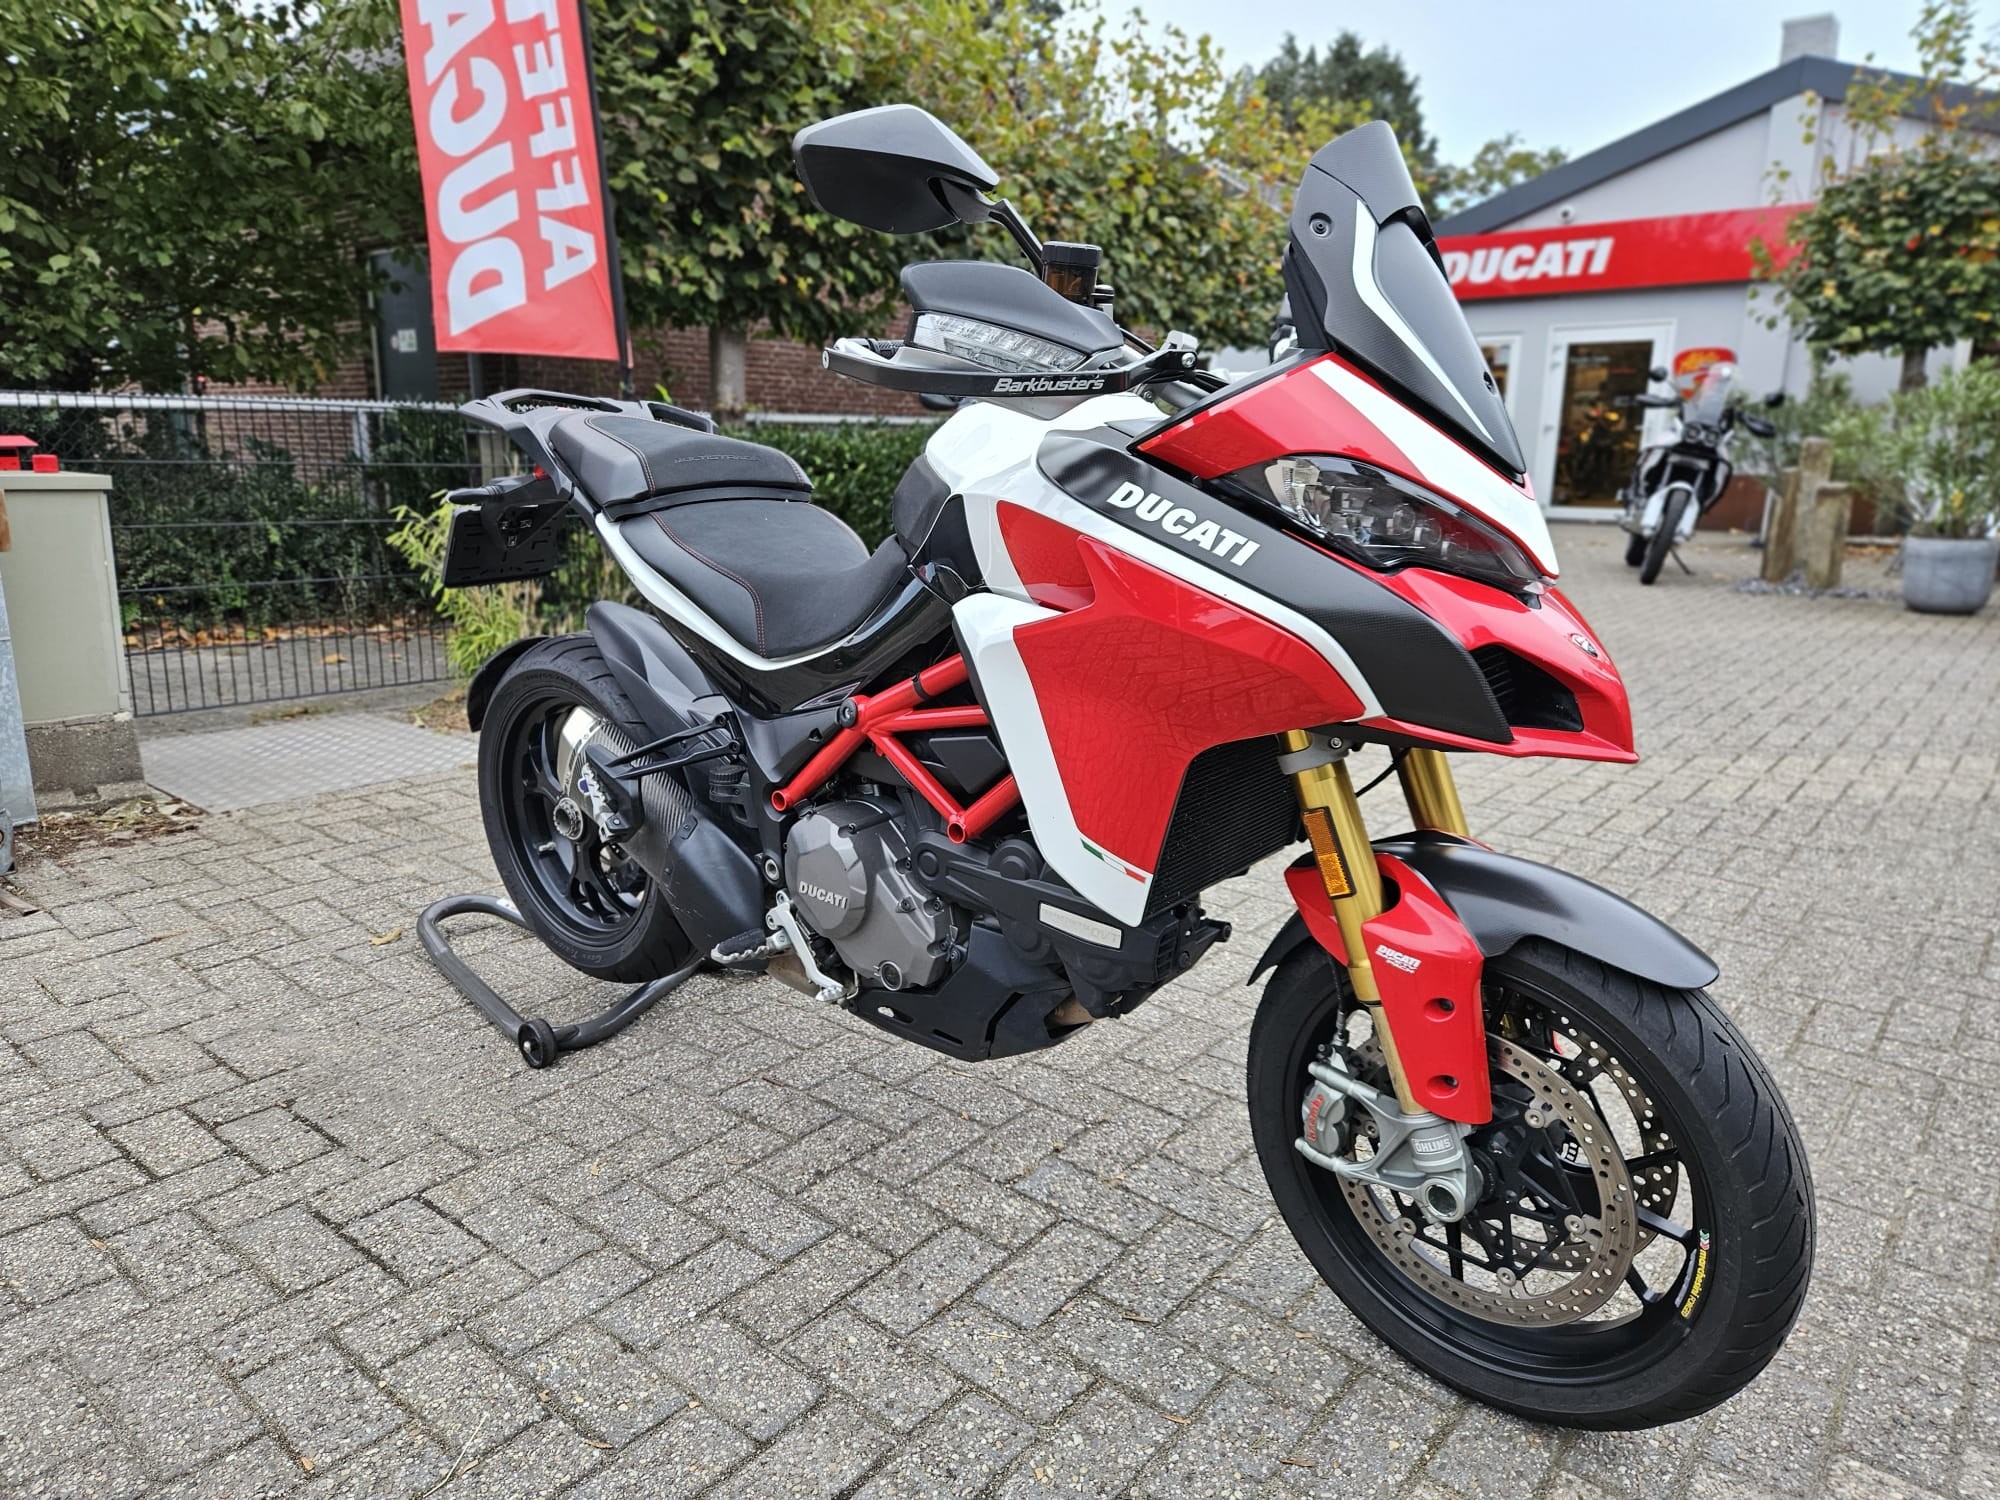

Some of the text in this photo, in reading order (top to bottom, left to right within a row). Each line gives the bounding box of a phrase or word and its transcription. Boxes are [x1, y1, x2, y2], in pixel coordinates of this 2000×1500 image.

[1442, 236, 1615, 287] DUCATI
[993, 377, 1105, 392] Barkbusters
[1106, 481, 1261, 567] DUCATI
[799, 880, 848, 910] DUCATI
[1375, 944, 1422, 968] DUCATI
